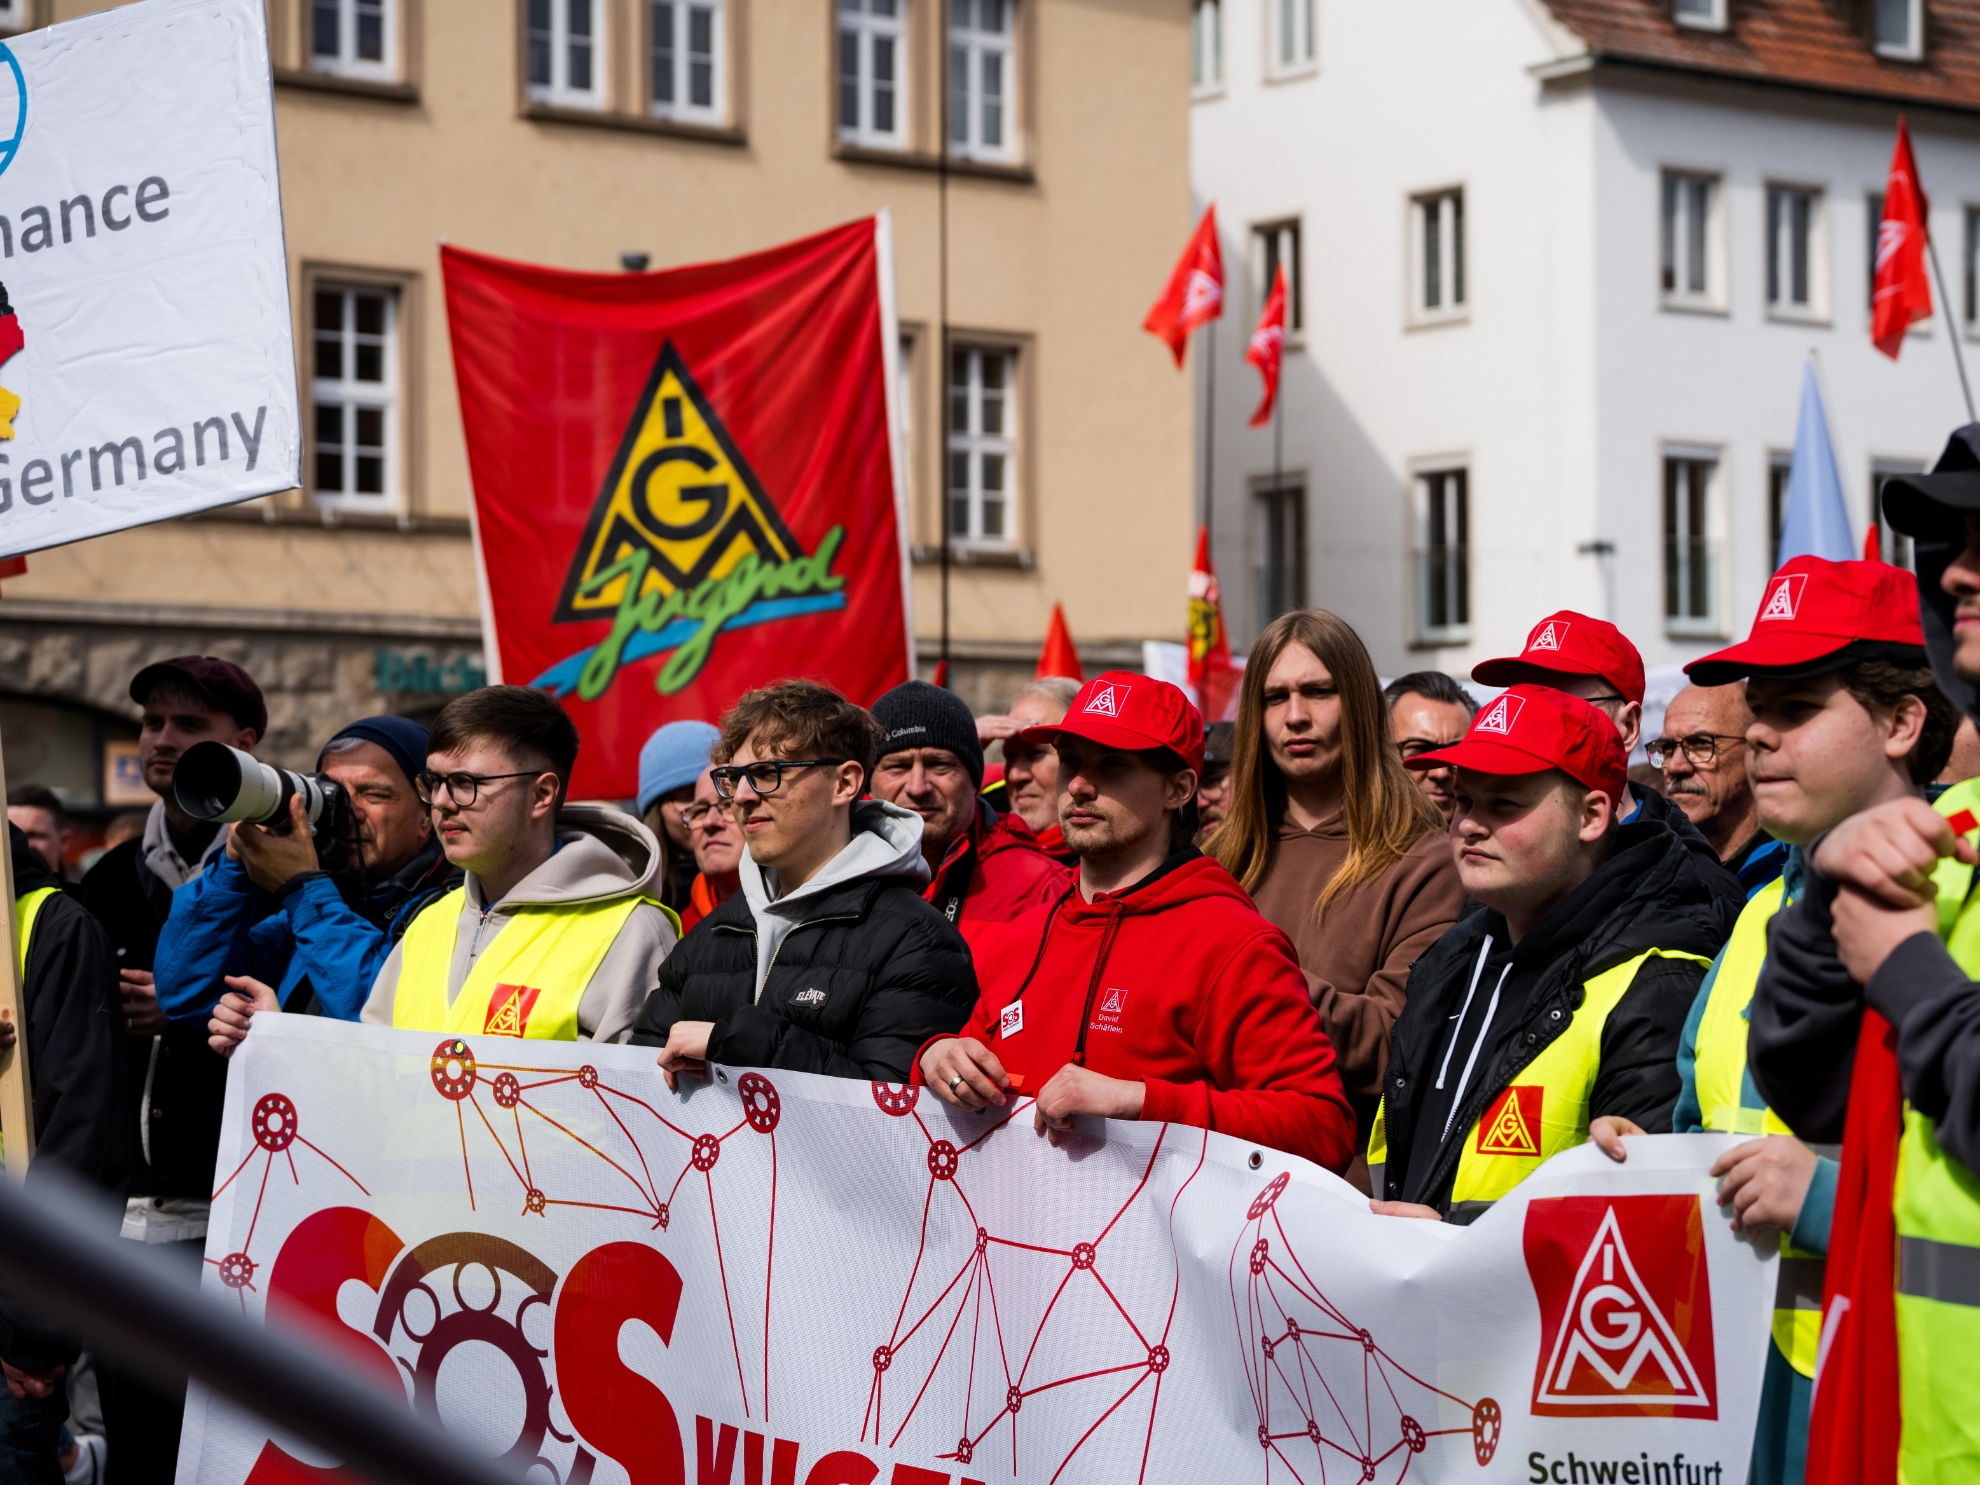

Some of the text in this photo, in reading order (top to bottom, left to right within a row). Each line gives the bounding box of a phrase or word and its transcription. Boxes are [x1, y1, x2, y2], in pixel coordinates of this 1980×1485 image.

[576, 523, 846, 700] Jugend
[891, 725, 927, 738] Columbia
[1098, 1013, 1119, 1023] David
[1090, 1021, 1123, 1034] Schäflein
[1528, 1451, 1723, 1485] Schweinfurt
